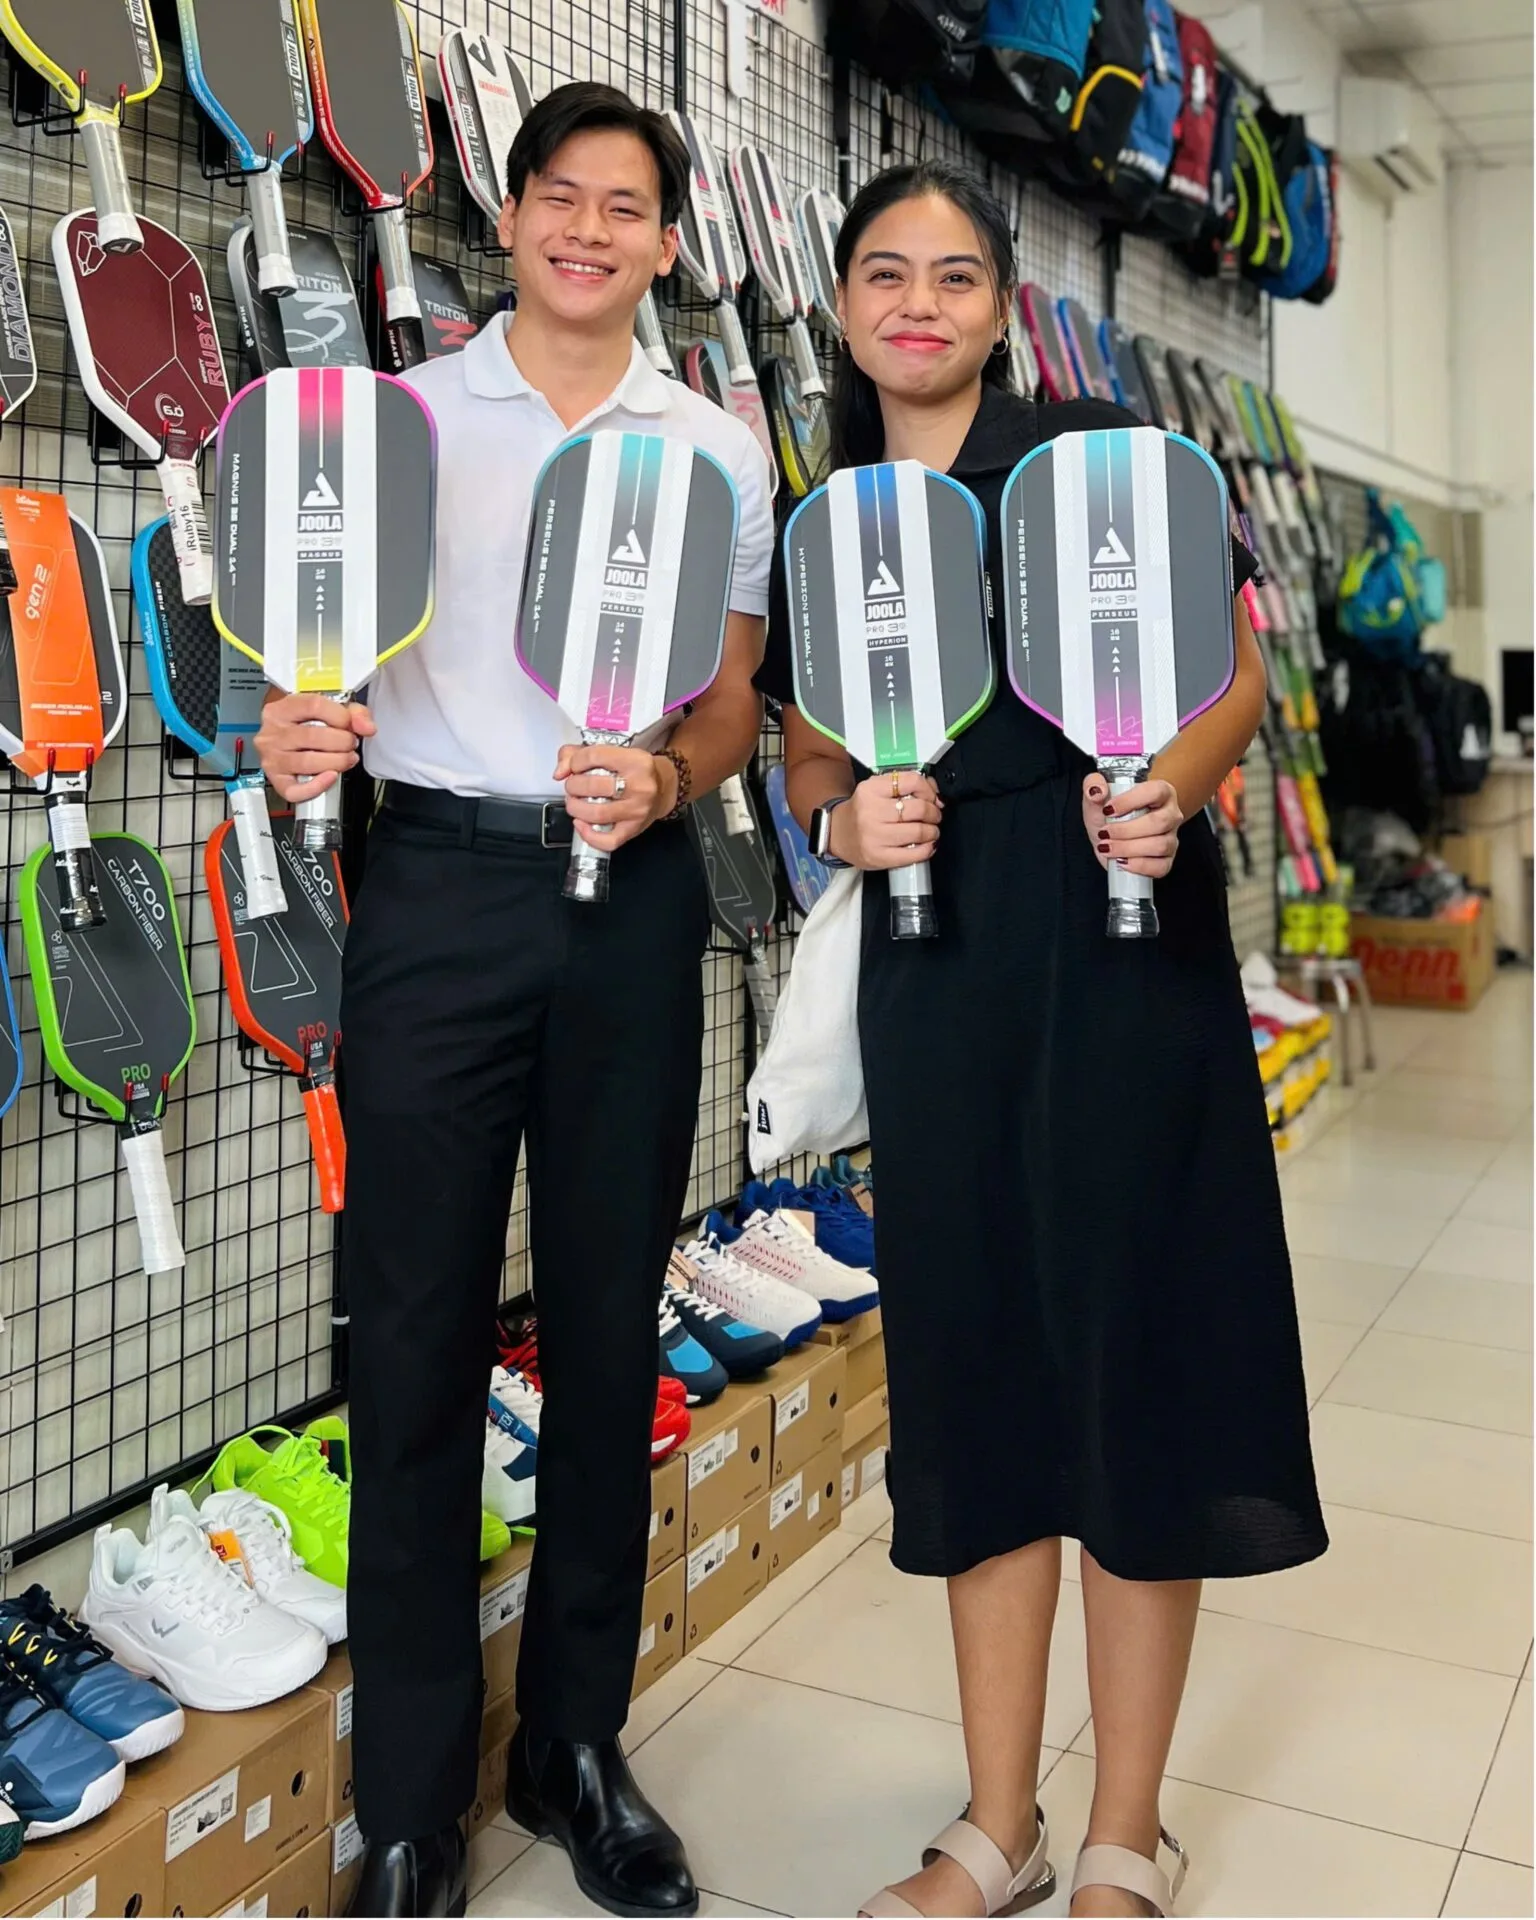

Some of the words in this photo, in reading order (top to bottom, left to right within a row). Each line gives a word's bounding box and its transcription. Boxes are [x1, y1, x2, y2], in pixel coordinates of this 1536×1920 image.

[295, 274, 342, 296] RITON
[424, 299, 470, 325] TRITON
[193, 314, 225, 387] RUBY
[231, 453, 240, 504] MAGNUS
[180, 504, 198, 552] iRuby16
[299, 515, 343, 531] JOOLA
[541, 499, 555, 555] PERSEUS
[230, 524, 239, 555] DUAL
[1017, 519, 1026, 578] PERSEUS
[299, 551, 341, 559] MAGNUS
[535, 572, 546, 604] DUAL
[605, 568, 646, 588] JOOLA
[1091, 572, 1136, 589] JOOLA
[156, 581, 166, 611] FIBER
[602, 603, 644, 613] PERSEUS
[799, 547, 808, 612] HYPERION
[804, 626, 813, 658] DUAL
[866, 601, 905, 621] JOOLA
[1090, 596, 1112, 605] PRO
[1021, 597, 1029, 630] DUAL
[1091, 610, 1137, 618] PERSEUS
[161, 613, 174, 657] CARBON
[866, 624, 885, 634] PRO
[868, 637, 907, 646] HYPERION
[281, 841, 314, 893] CARBON
[311, 894, 334, 929] FIBER
[303, 851, 333, 896] 700
[107, 859, 142, 914] CARBON
[139, 914, 163, 951] FIBER
[128, 859, 165, 921] T700
[297, 1021, 327, 1043] PRO
[121, 1063, 151, 1084] PRO
